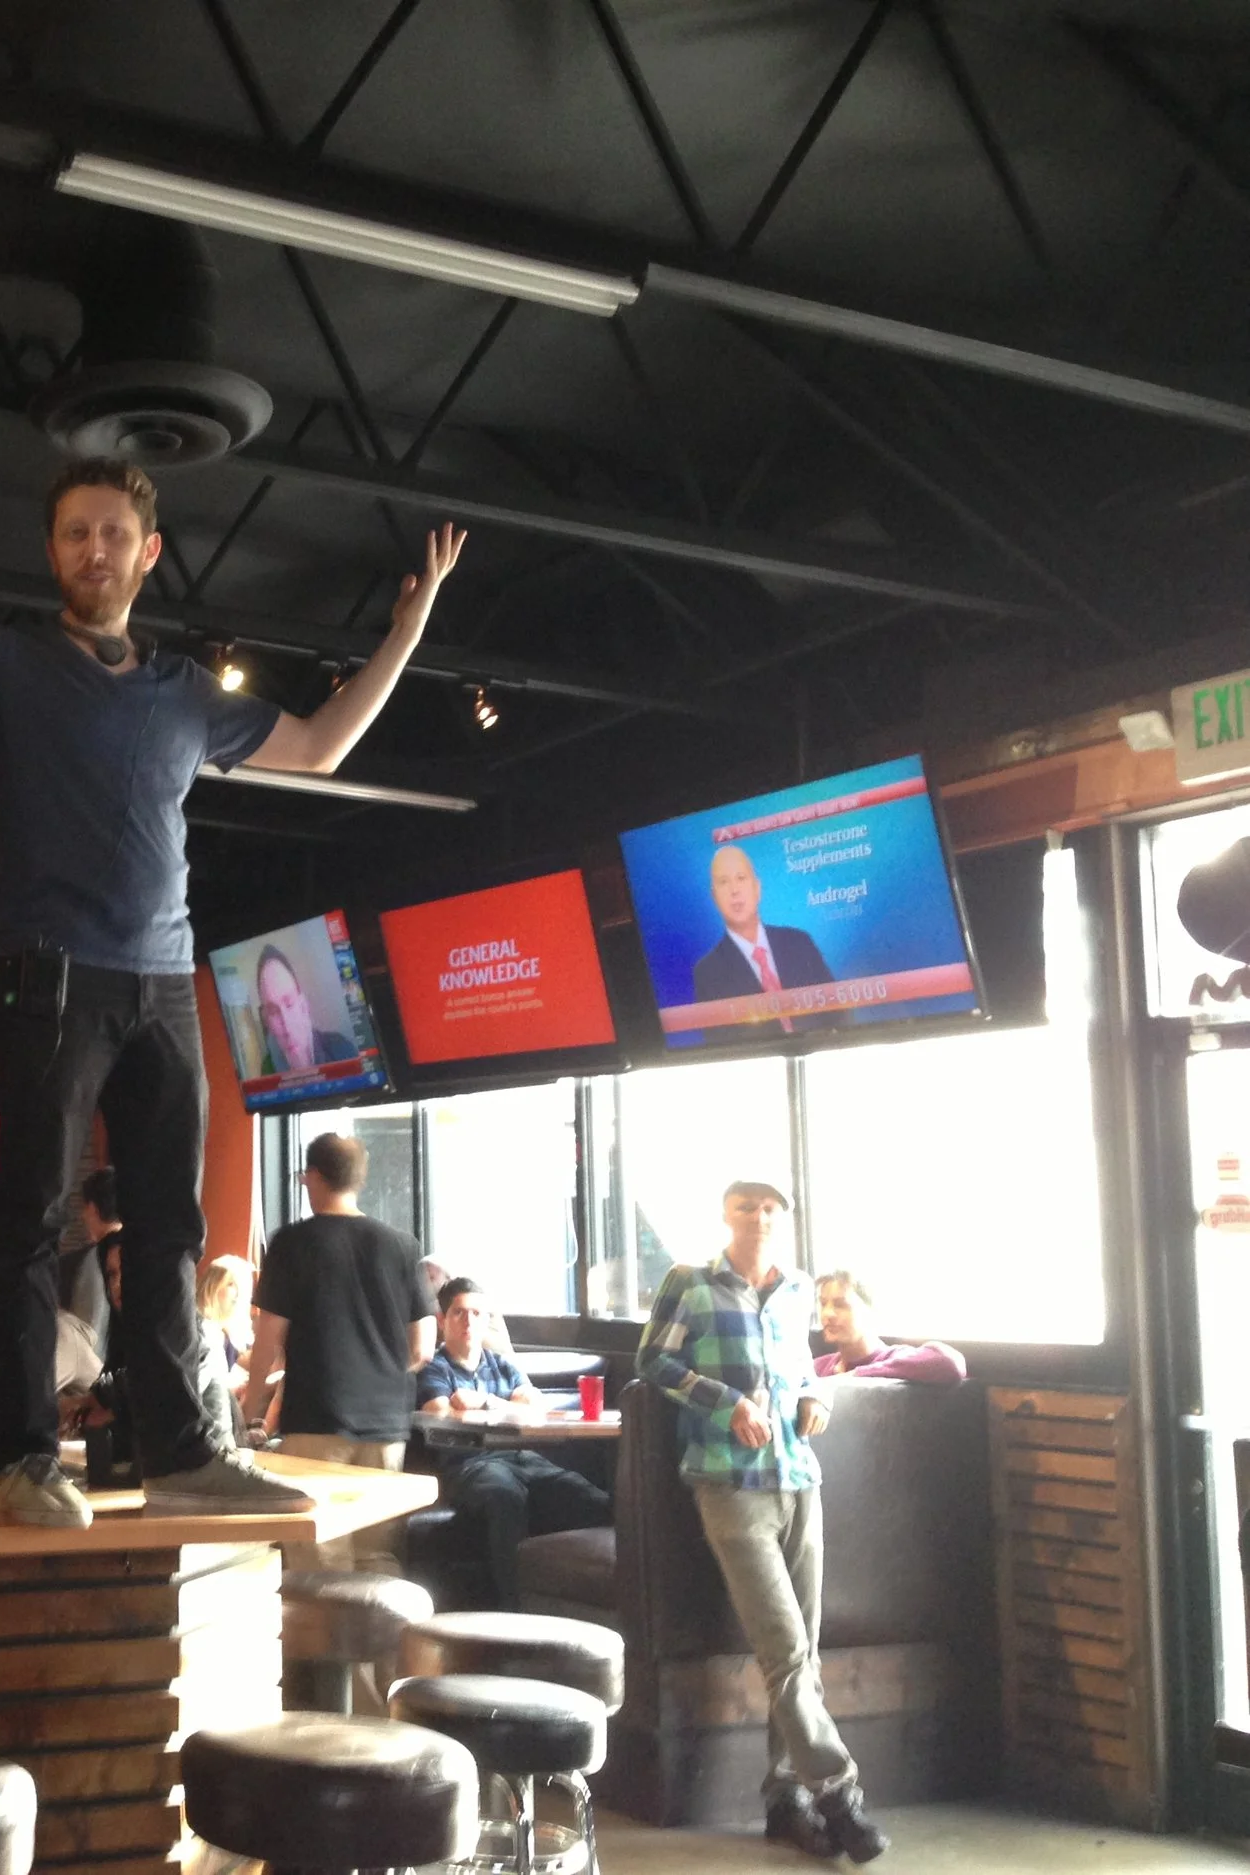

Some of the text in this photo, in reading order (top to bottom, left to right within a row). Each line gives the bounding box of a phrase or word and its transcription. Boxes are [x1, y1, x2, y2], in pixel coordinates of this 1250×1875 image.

[782, 824, 868, 853] Testosterone
[786, 842, 872, 875] Supplements
[807, 879, 868, 906] Androgel
[449, 938, 520, 968] GENERAL
[439, 957, 541, 992] KNOWLEDGE
